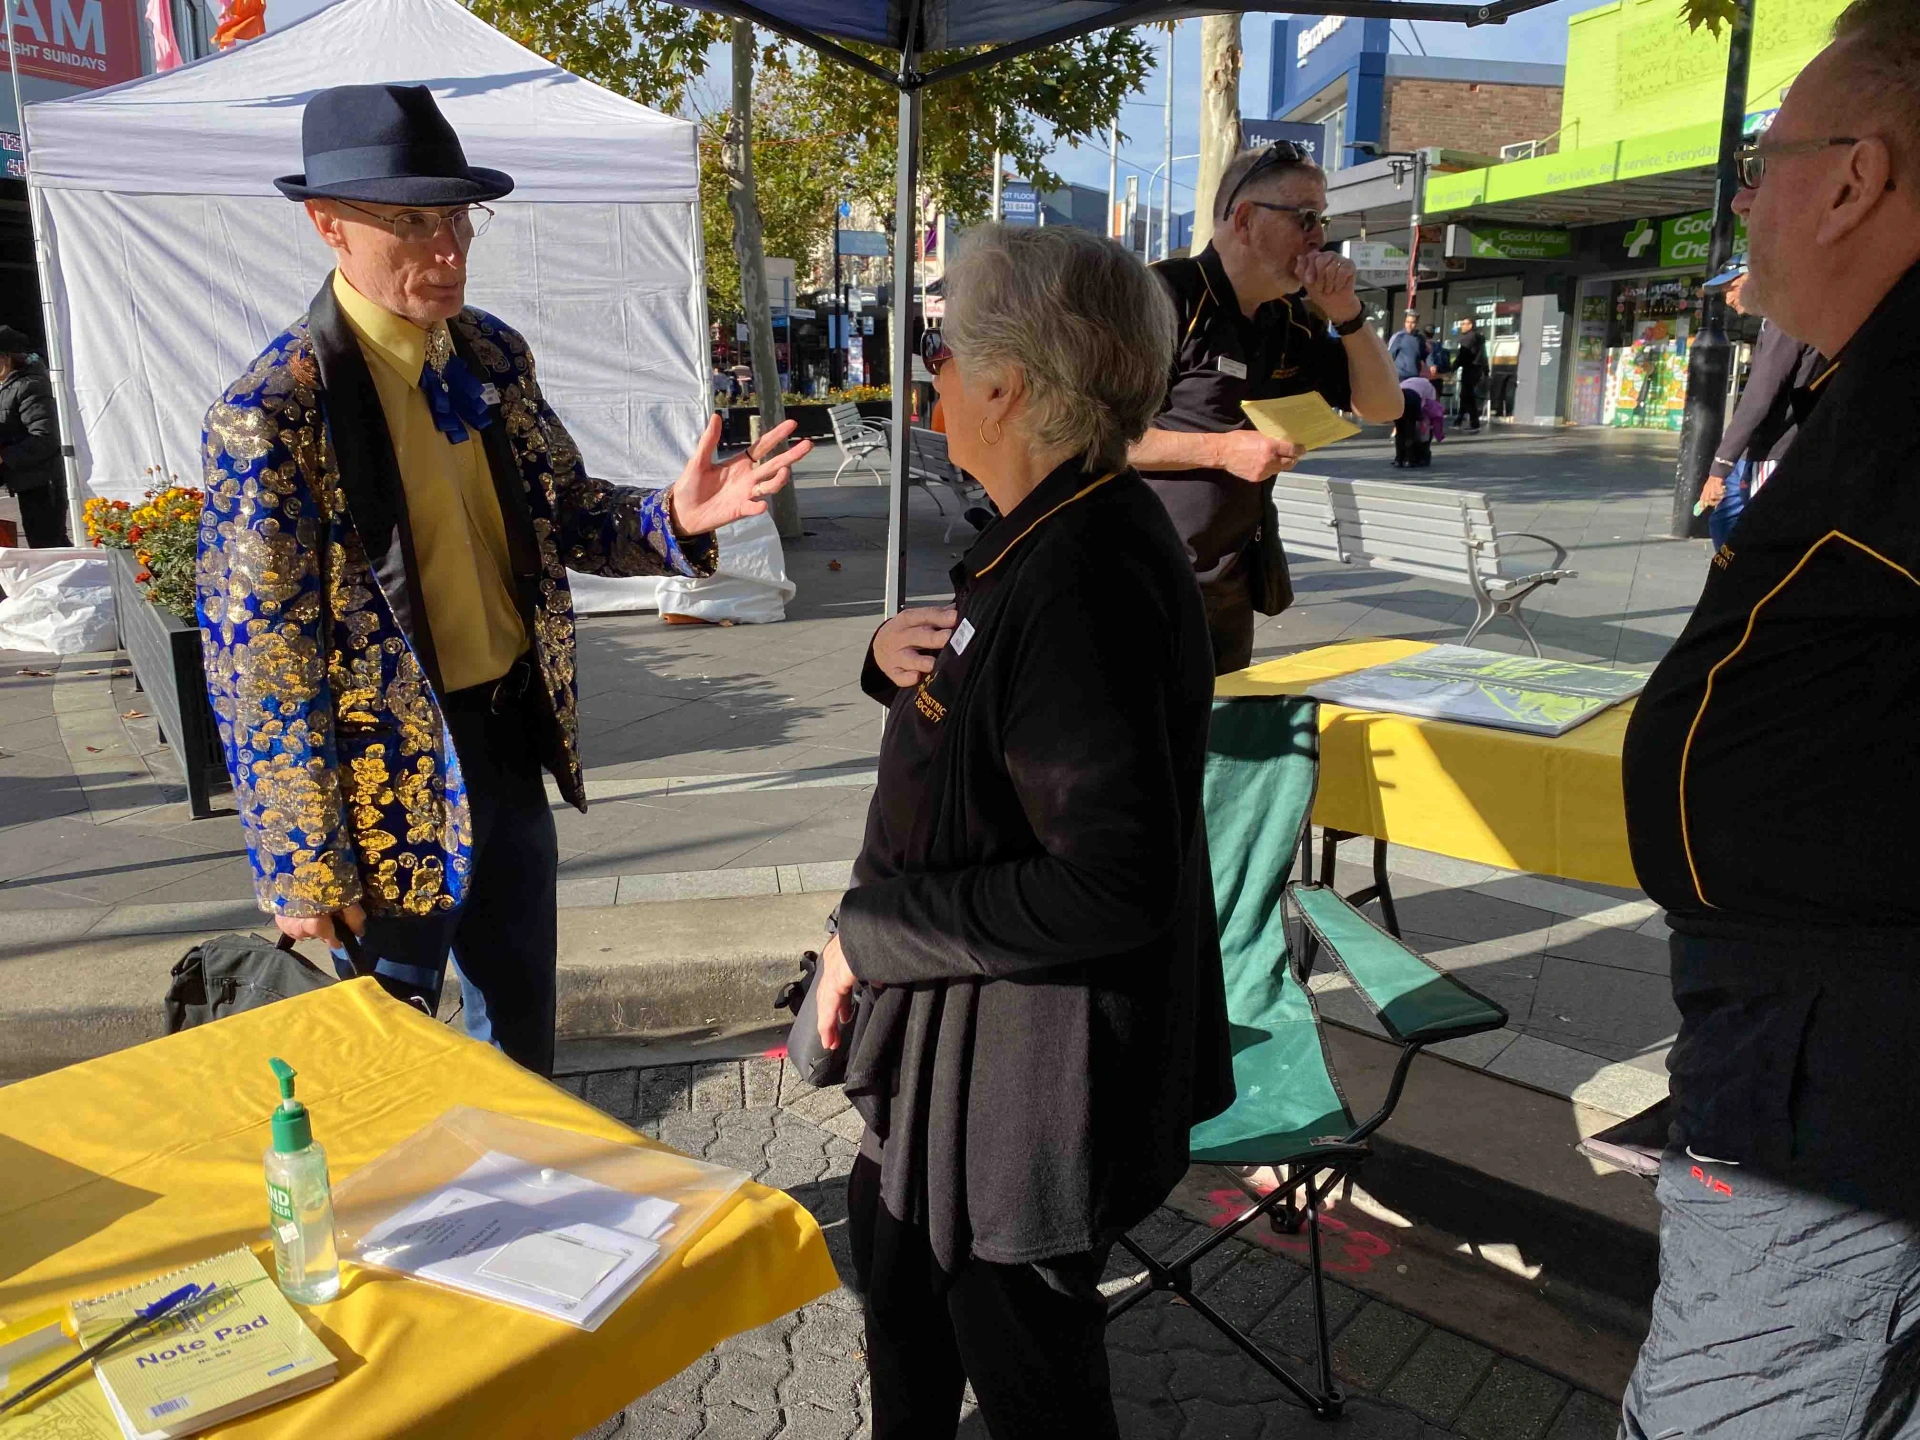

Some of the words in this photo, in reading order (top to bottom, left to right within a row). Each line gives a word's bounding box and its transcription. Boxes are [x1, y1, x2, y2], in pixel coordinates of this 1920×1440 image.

[42, 47, 107, 72] SUNDAYS
[1546, 172, 1567, 185] Best
[1667, 143, 1718, 164] Everyday
[1499, 230, 1532, 242] Good
[1534, 231, 1567, 244] Value
[1498, 244, 1546, 257] Chemist
[915, 697, 941, 723] SOCIETY
[136, 1338, 206, 1369] Note
[214, 1314, 270, 1342] Pad
